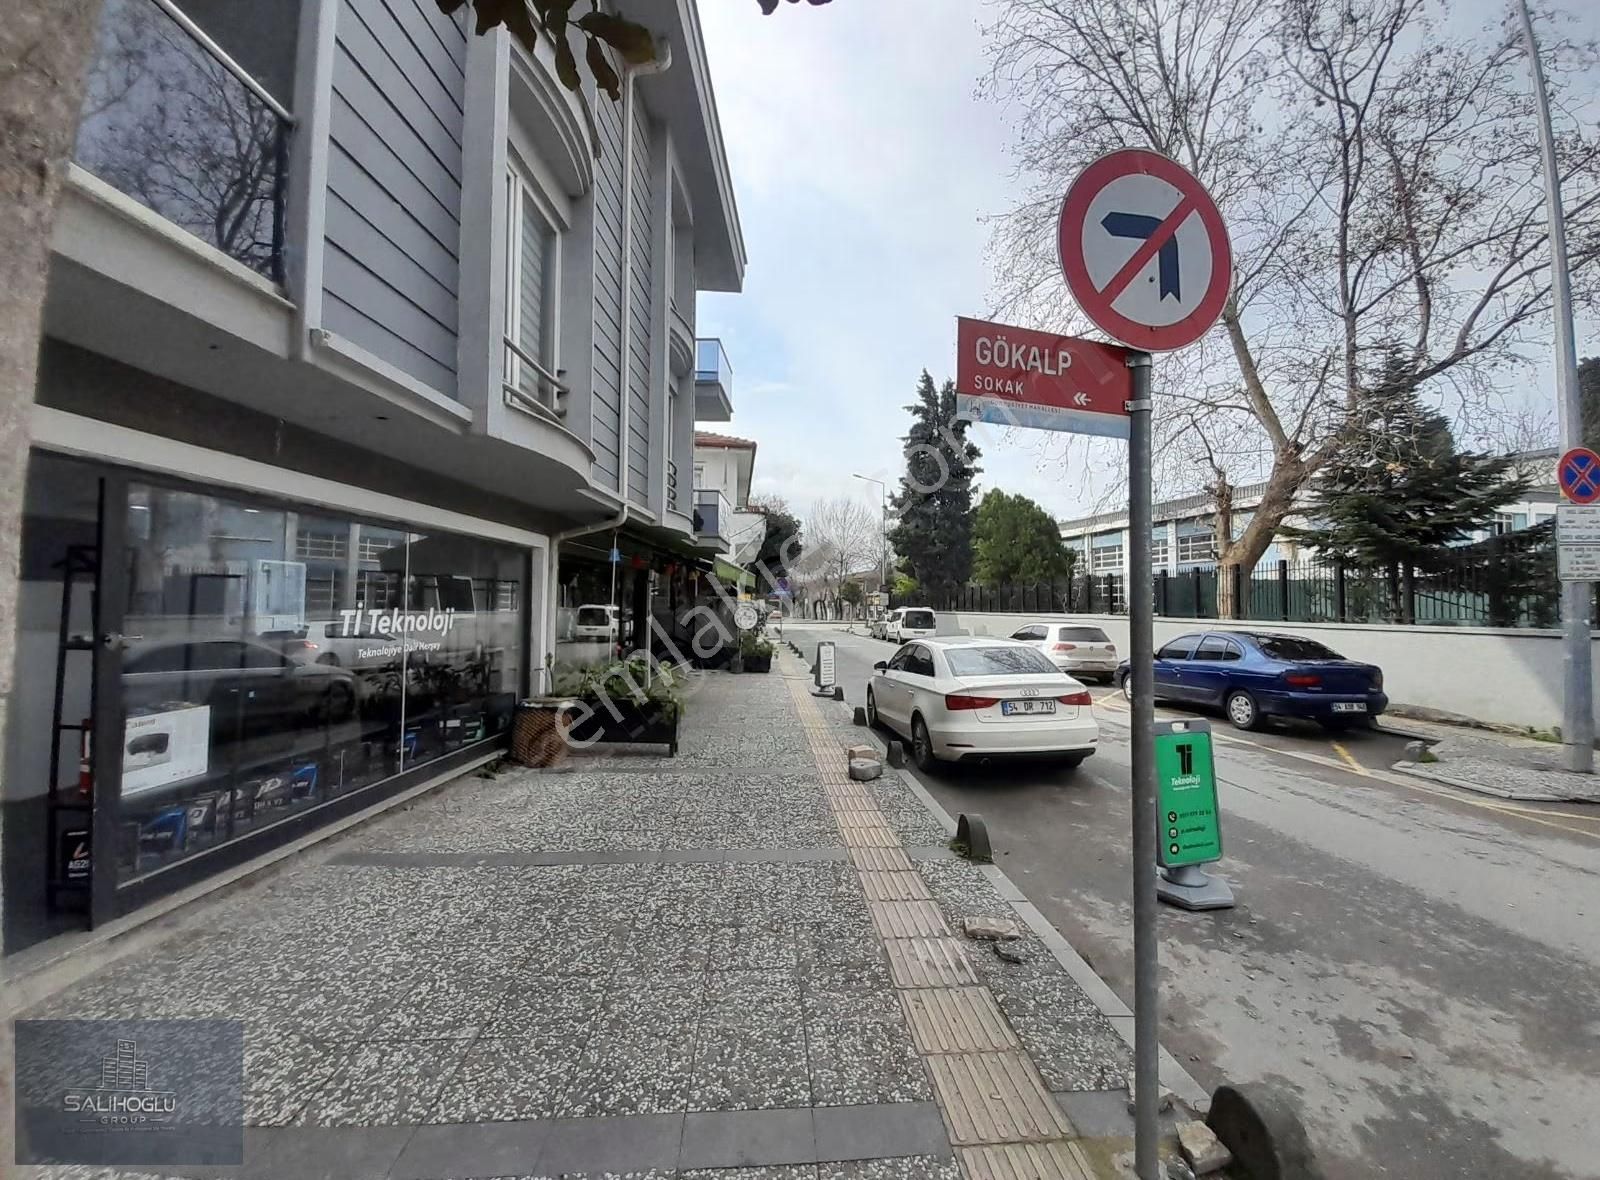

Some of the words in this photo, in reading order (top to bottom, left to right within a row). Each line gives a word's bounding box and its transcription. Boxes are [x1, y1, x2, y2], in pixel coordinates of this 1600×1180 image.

[975, 335, 1072, 376] GÖKALP
[974, 375, 1024, 395] SOKAK
[368, 607, 455, 637] Teknoloji
[1009, 702, 1018, 711] 54
[1040, 702, 1054, 710] 712
[1171, 775, 1201, 786] Teknoloji
